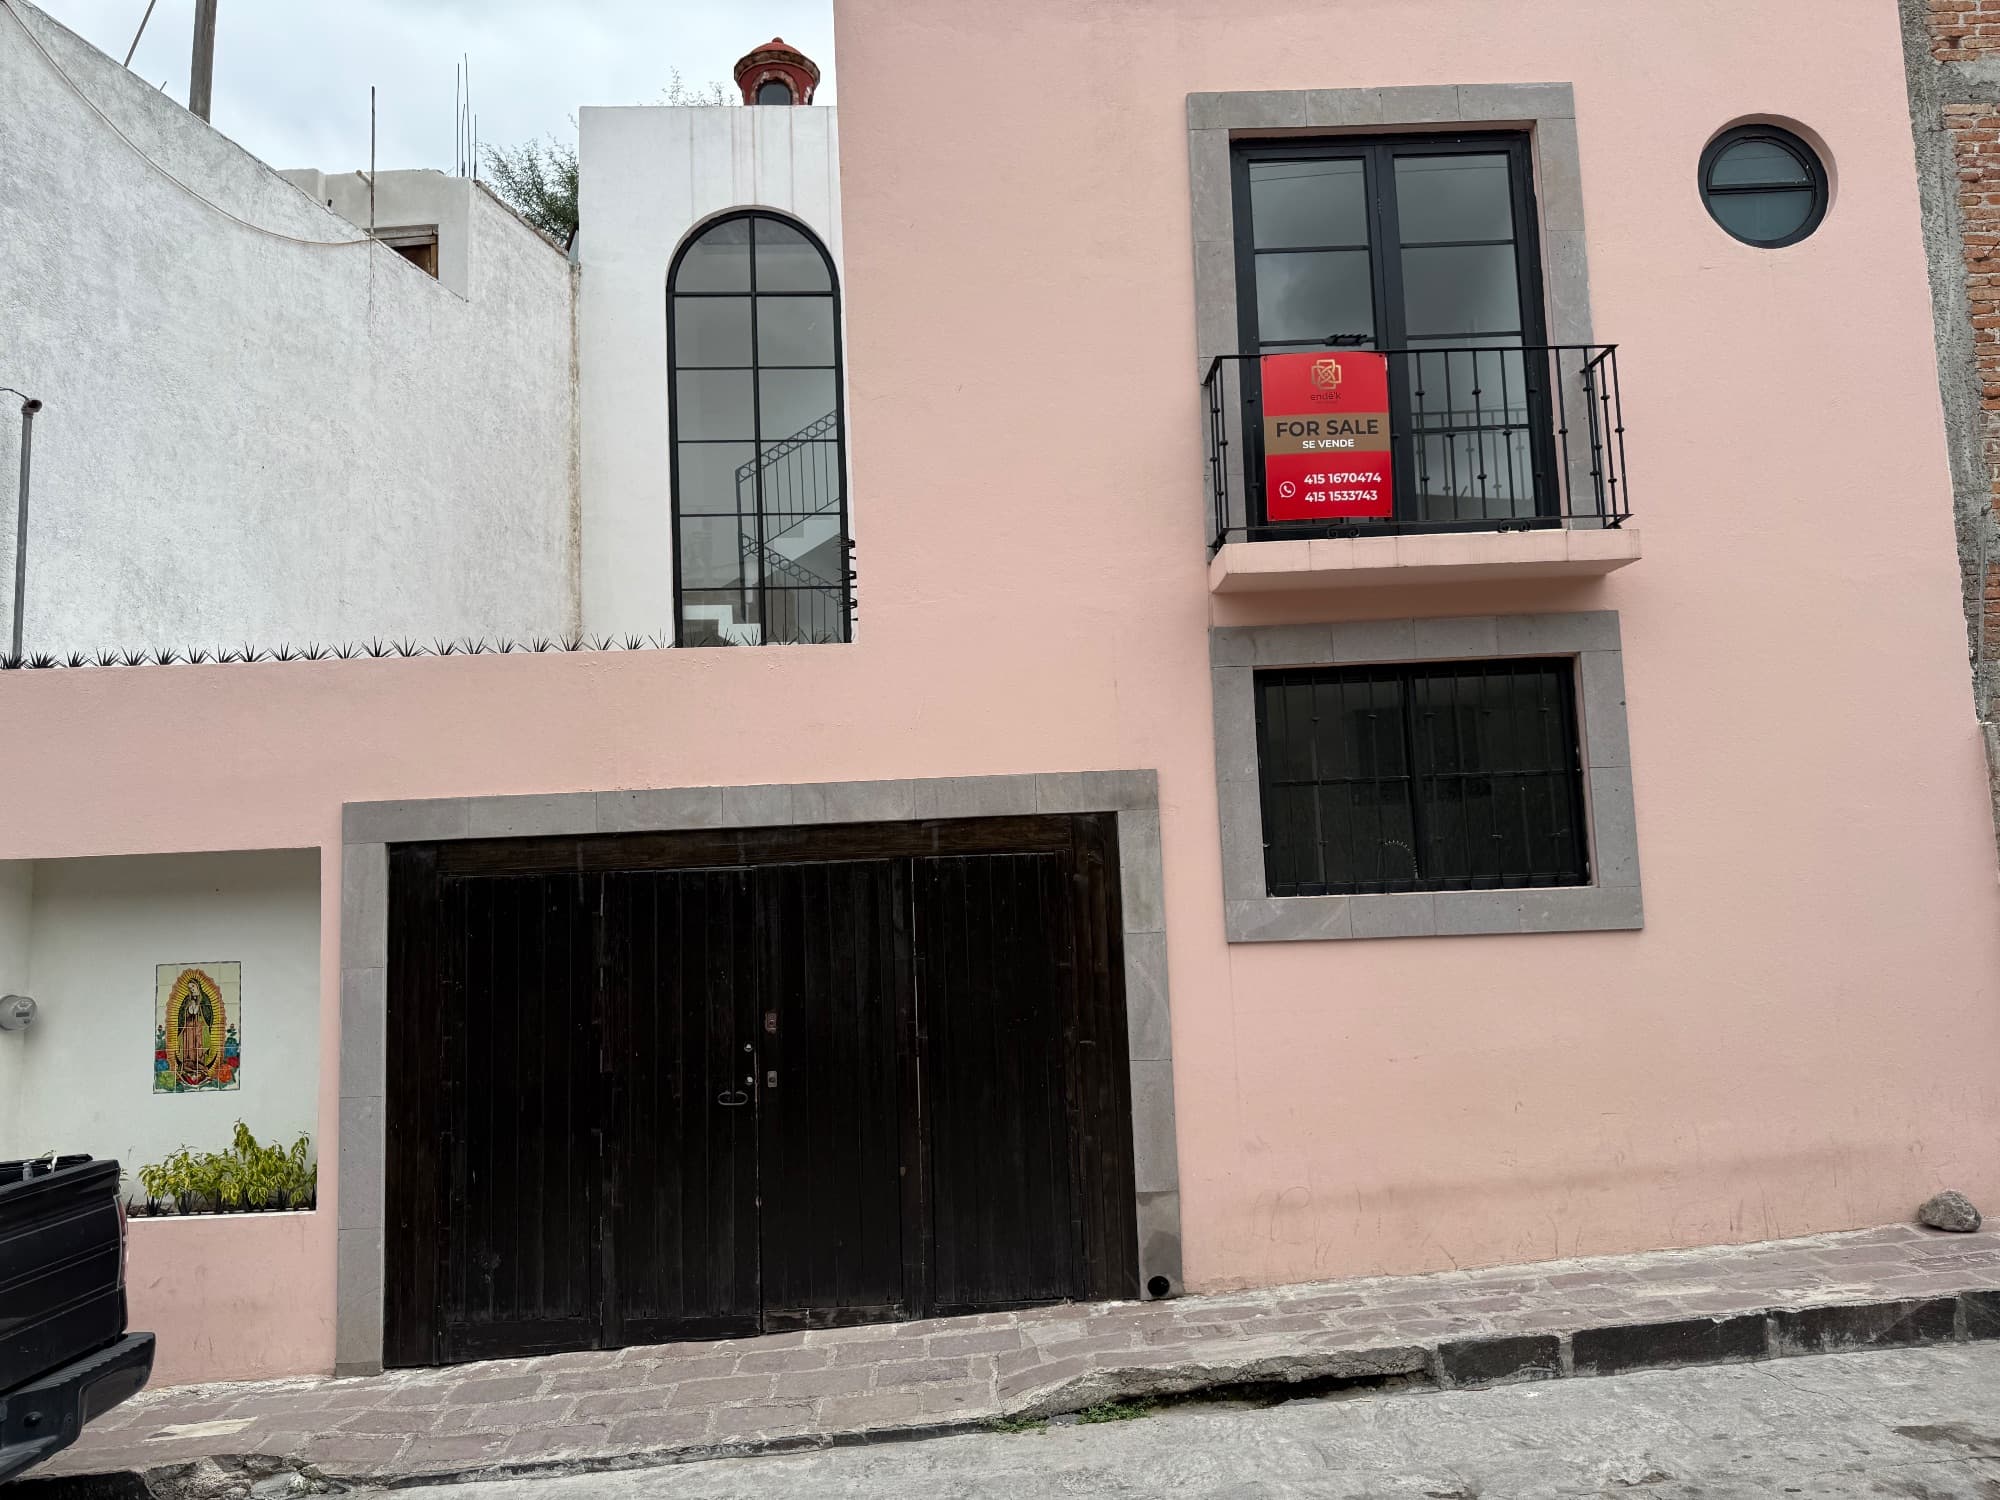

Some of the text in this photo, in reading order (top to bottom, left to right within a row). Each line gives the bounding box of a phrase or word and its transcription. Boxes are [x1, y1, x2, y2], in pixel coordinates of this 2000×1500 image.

[1276, 419, 1379, 438] FOR SALE
[1302, 439, 1355, 449] SE VENDE
[1303, 472, 1382, 485] 415 1670474
[1304, 490, 1378, 503] 415 1533743
